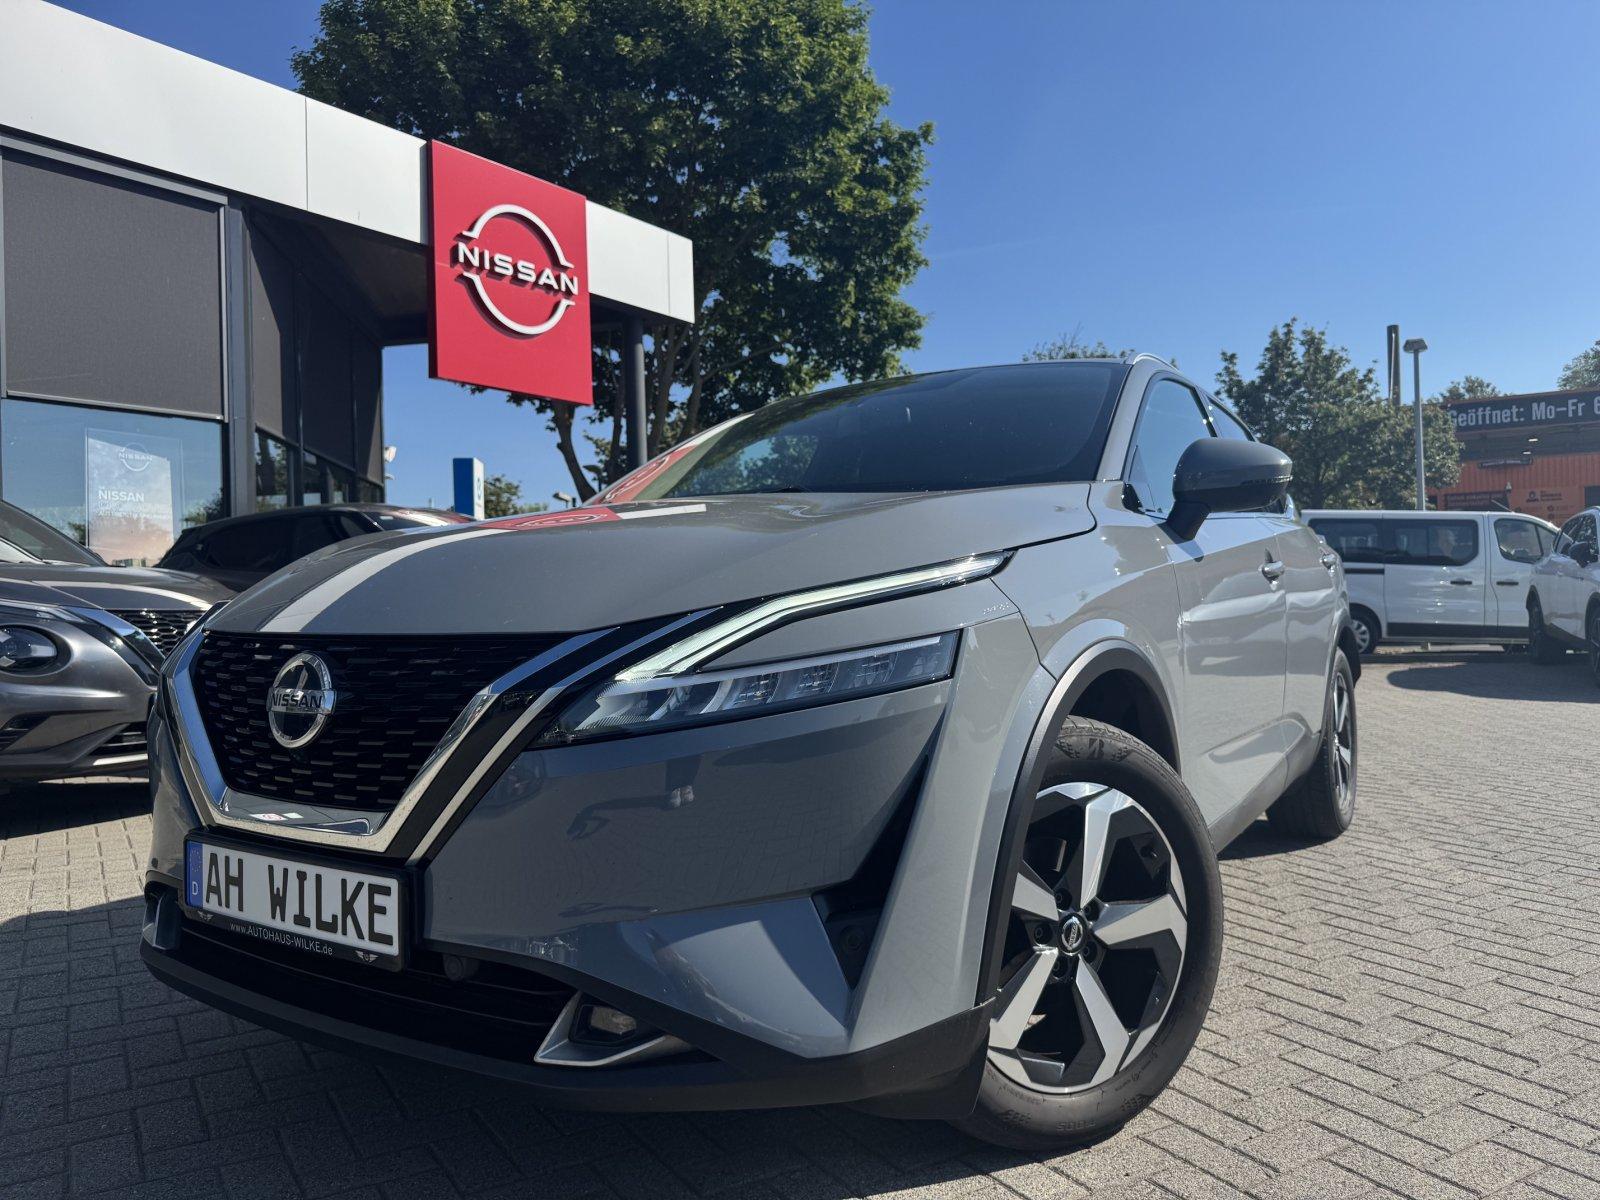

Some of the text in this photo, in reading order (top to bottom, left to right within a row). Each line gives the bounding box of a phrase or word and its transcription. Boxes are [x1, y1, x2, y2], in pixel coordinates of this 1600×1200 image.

[458, 242, 578, 295] NISSAN
[1532, 398, 1586, 421] Mo-Fr
[118, 452, 153, 462] NISSAN
[98, 489, 145, 502] NISSAN
[272, 692, 323, 709] NISSAN
[191, 880, 199, 896] D
[205, 852, 394, 946] AH WILKE
[229, 923, 333, 956] www.AUTOHAUS-WILKE.de
